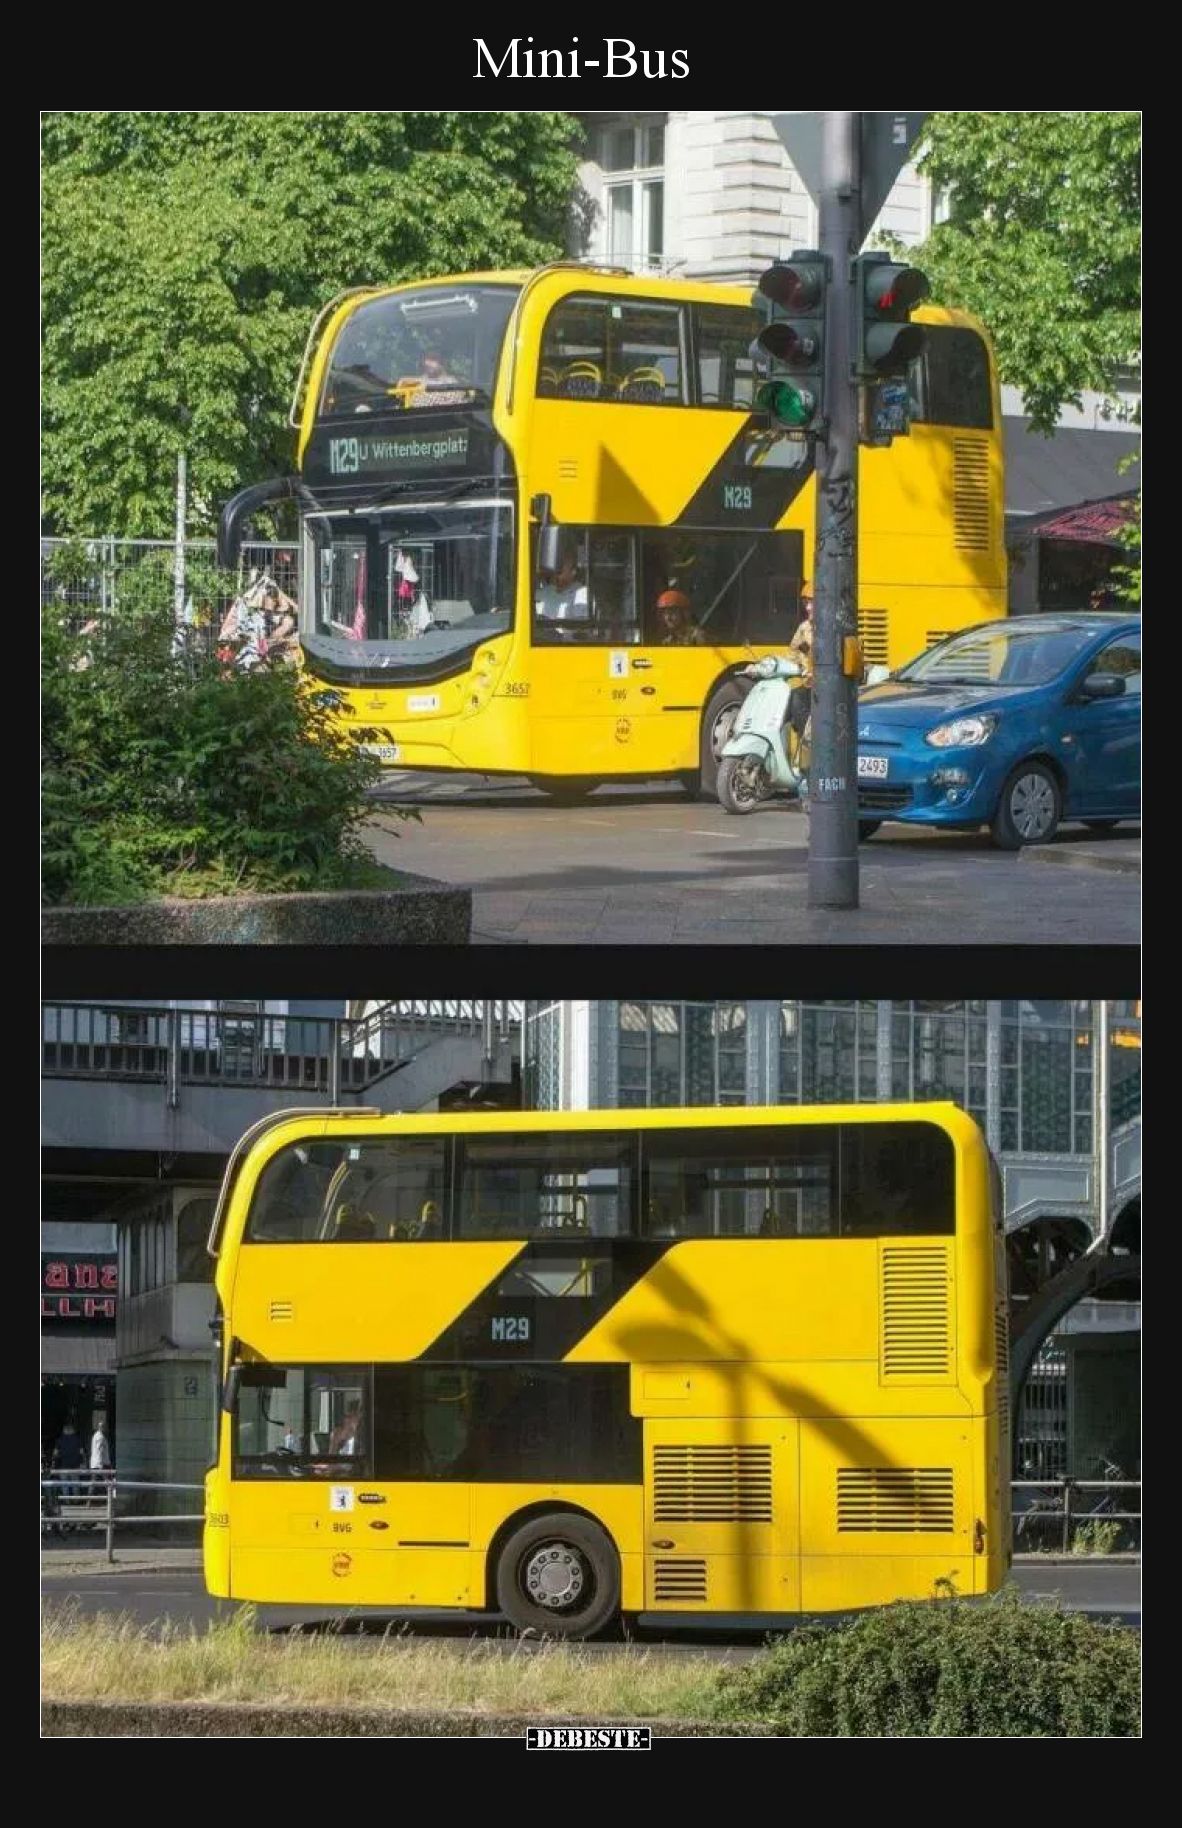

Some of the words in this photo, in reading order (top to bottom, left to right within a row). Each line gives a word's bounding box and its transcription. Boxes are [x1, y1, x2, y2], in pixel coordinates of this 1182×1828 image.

[329, 437, 359, 474] M29
[359, 442, 369, 460] U
[859, 758, 887, 774] 2493
[491, 1317, 529, 1340] M29
